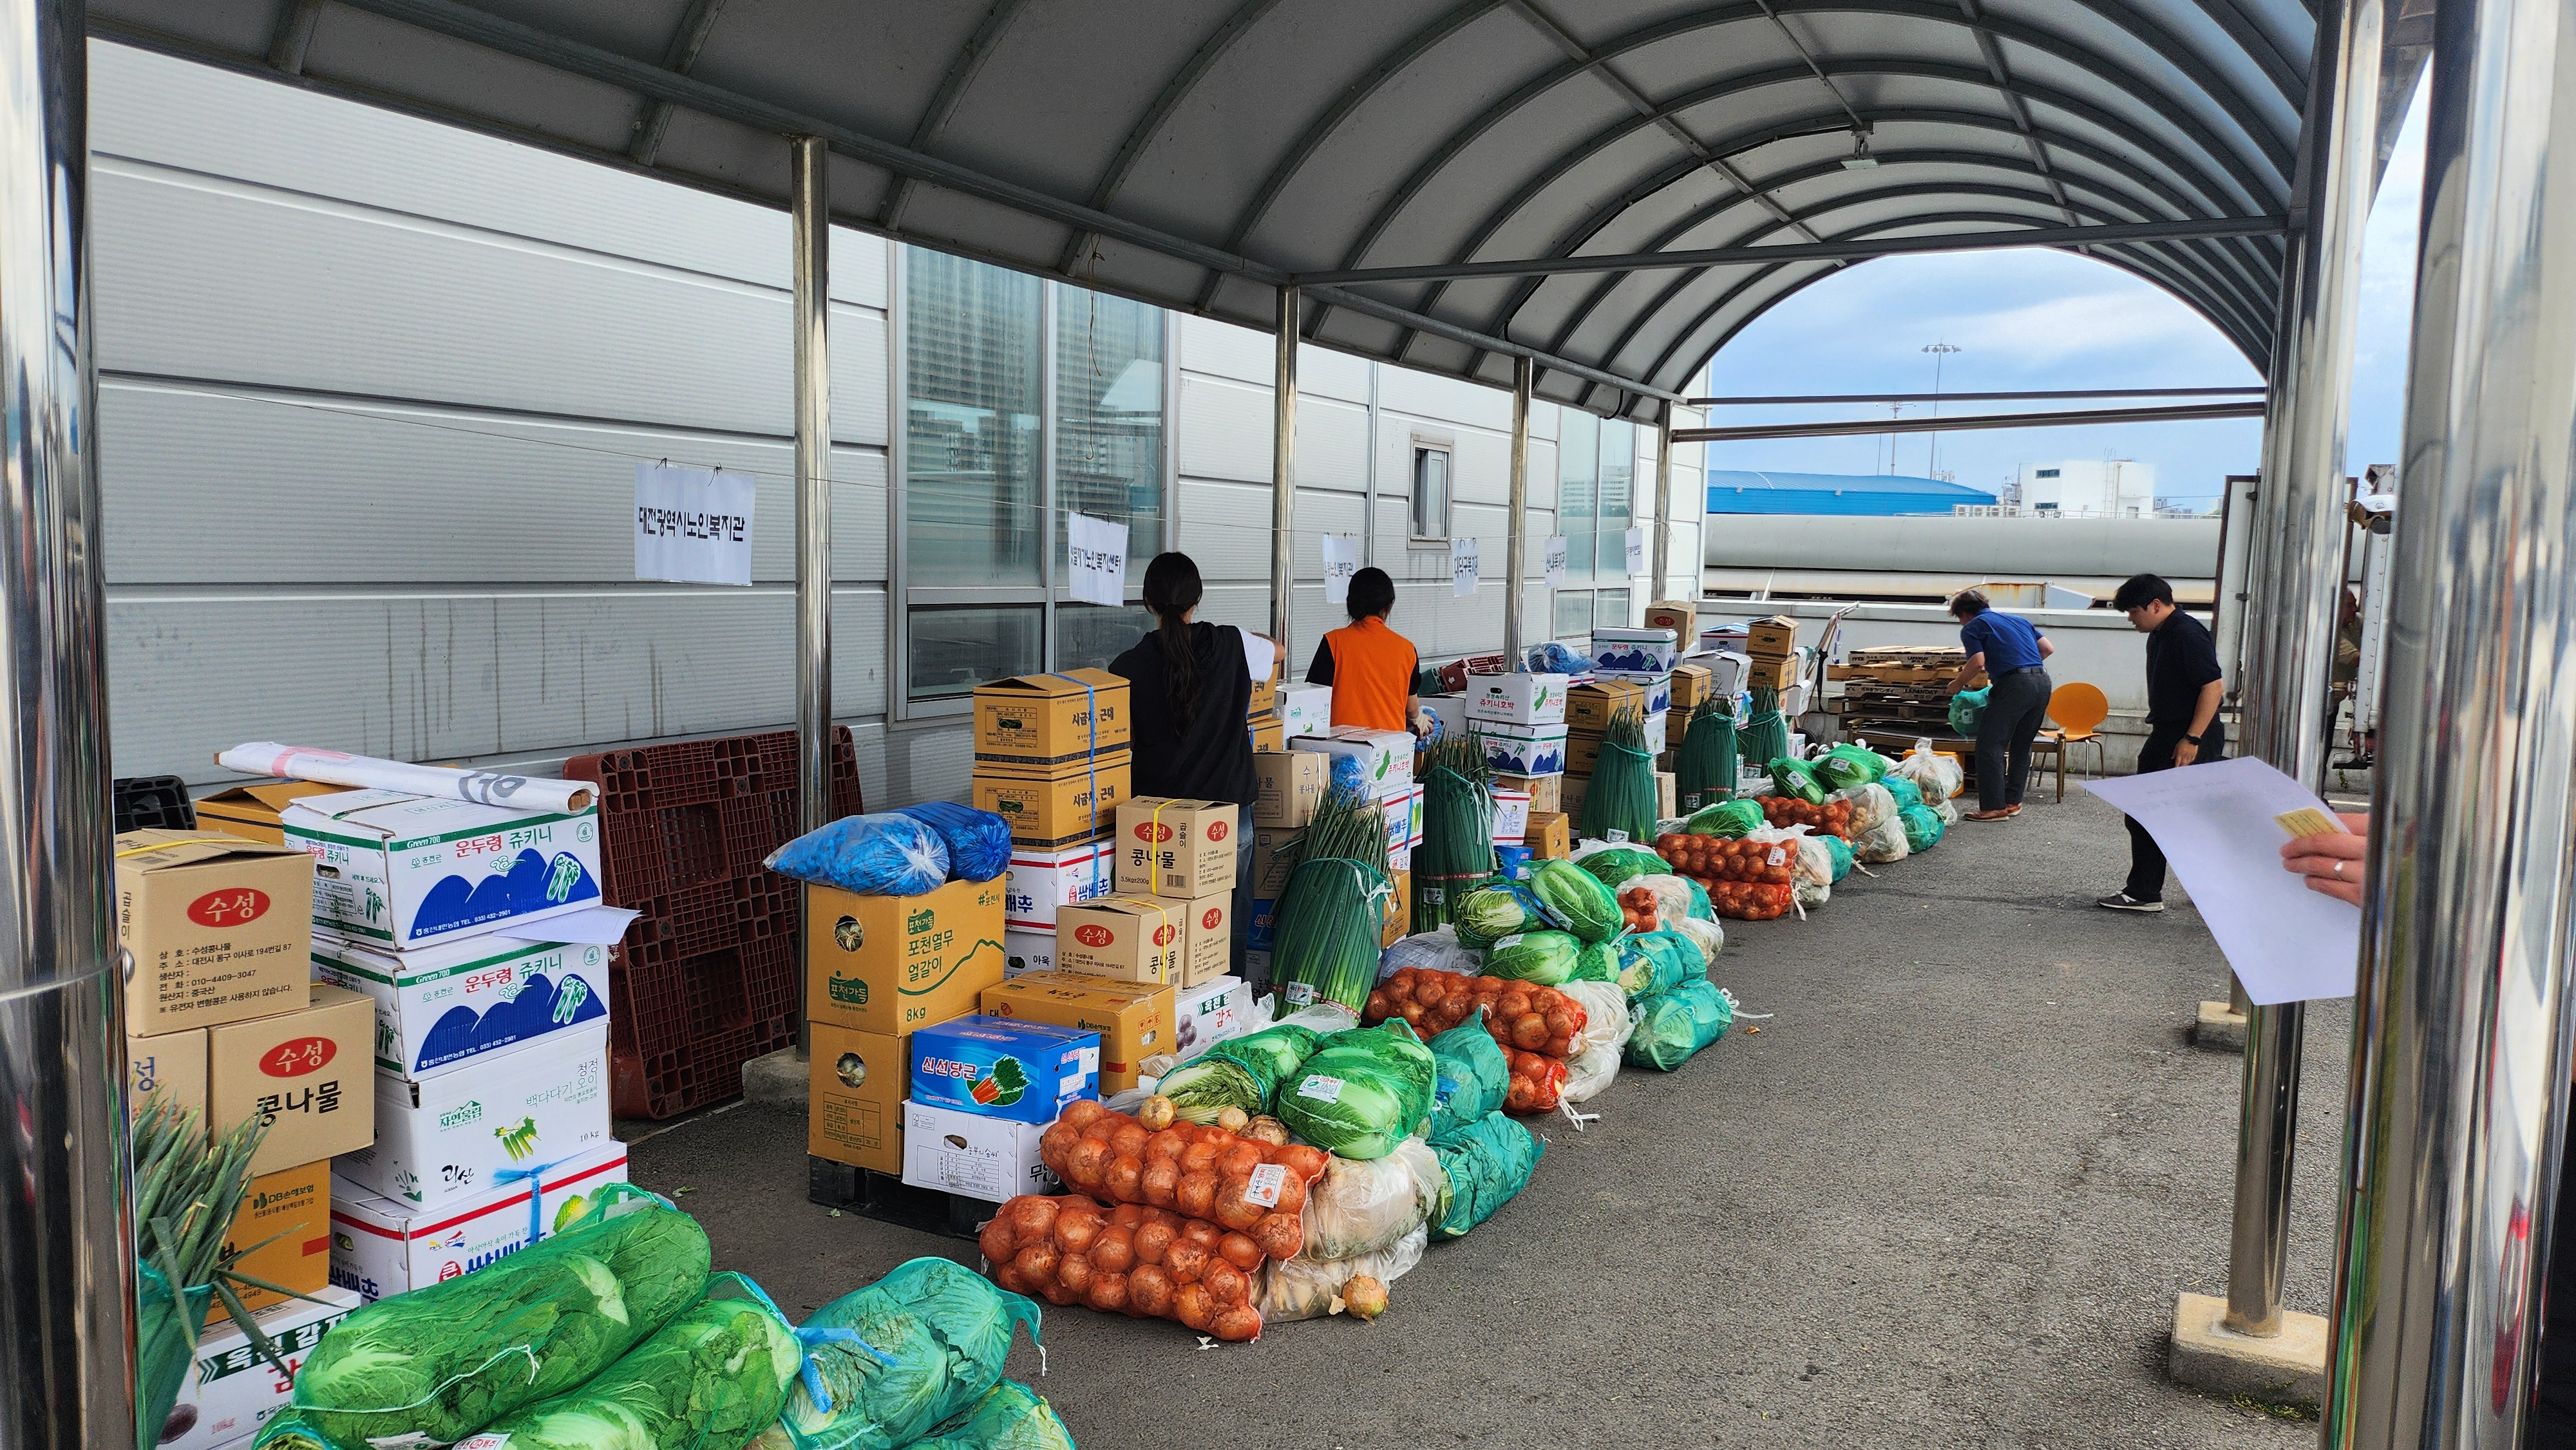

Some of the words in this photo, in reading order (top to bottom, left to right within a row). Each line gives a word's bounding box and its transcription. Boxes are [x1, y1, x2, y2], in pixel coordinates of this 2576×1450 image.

[639, 506, 745, 542] 대전광역시노인복지관
[1454, 555, 1478, 579] 대덕구복지관
[1099, 707, 1114, 721] 근대
[1480, 699, 1514, 710] 쥬키니호박
[1100, 786, 1115, 800] 근대
[1142, 825, 1166, 840] 수성
[1211, 824, 1225, 839] 수성
[455, 834, 502, 858] 운두령
[509, 825, 553, 849] 쥬키니
[327, 849, 349, 865] 쥬키니
[1131, 849, 1175, 869] 콩나물
[205, 892, 255, 923] 수성
[486, 909, 511, 920] 432-2901
[909, 916, 934, 934] 포천가득
[1206, 910, 1219, 927] 수성
[908, 929, 954, 957] 포천열무
[1083, 927, 1106, 945] 수성
[158, 951, 168, 959] 상
[175, 949, 184, 957] 호
[191, 943, 231, 955] 수성콩나물
[158, 962, 168, 970] 주
[192, 954, 214, 966] 대전시
[216, 952, 232, 962] 동구
[233, 949, 254, 959] 이사로
[256, 944, 281, 956] 194번길
[1033, 955, 1050, 966] 아욱
[158, 970, 184, 981] 생산자
[465, 967, 512, 993] 운두령
[519, 954, 562, 979] 쥬키니
[908, 956, 942, 983] 얼갈이
[158, 983, 167, 992] 전
[175, 981, 184, 989] 화
[191, 969, 257, 986] 010-4409-3047
[158, 992, 184, 1003] 원산지
[191, 986, 216, 997] 중국산
[169, 1001, 194, 1012] 유전자
[196, 996, 228, 1008] 변형콩은
[230, 990, 260, 1002] 사용하지
[262, 984, 292, 996] 않습니다.
[831, 984, 867, 1003] 포천가득
[1204, 995, 1221, 1012] 옥천
[906, 1006, 926, 1022] 8kg
[276, 1040, 322, 1073] 수성
[1061, 1048, 1086, 1064] 신선당
[577, 1058, 598, 1077] 청정
[922, 1057, 978, 1080] 신선당근
[526, 1082, 573, 1107] 백다다기
[576, 1072, 598, 1090] 오이
[256, 1080, 343, 1127] 콩나물
[439, 1106, 482, 1129] 자연울림
[580, 1133, 589, 1142] 10
[590, 1129, 600, 1139] kg
[968, 1144, 984, 1156] 농부의
[441, 1164, 475, 1185] 괴산
[269, 1184, 314, 1203] DB손해보험
[468, 1239, 493, 1254] 아삭아삭
[495, 1234, 507, 1245] 속이
[508, 1230, 520, 1239] 가득
[522, 1227, 528, 1235] 찬
